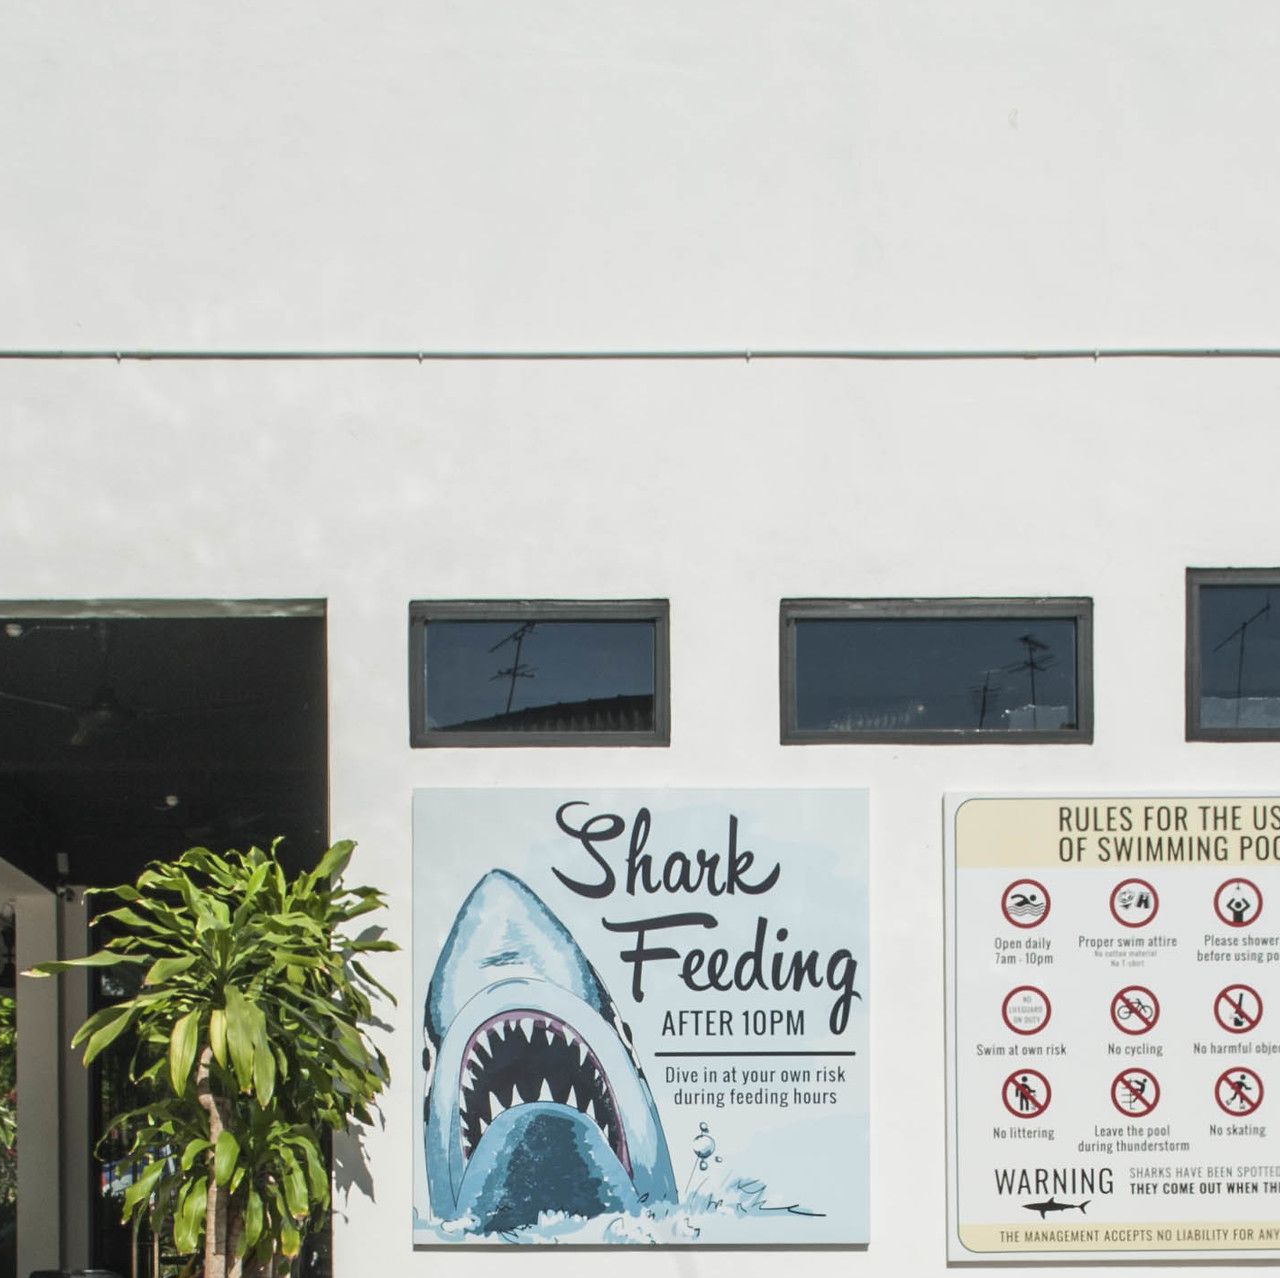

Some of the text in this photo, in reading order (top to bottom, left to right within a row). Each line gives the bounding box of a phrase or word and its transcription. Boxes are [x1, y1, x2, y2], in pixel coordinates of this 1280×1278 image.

[1059, 806, 1132, 832] RULES
[1145, 806, 1187, 831] FOR
[1198, 806, 1242, 830] THE
[552, 801, 780, 898] Shark
[1059, 837, 1087, 862] OF
[1098, 836, 1228, 862] SWIMMING
[995, 938, 1051, 951] Open daily
[1079, 936, 1177, 950] Proper swim attire
[1205, 934, 1279, 946] Please shower
[996, 952, 1016, 964] 7am
[1026, 952, 1053, 966] 10pm
[1197, 949, 1231, 962] before
[1234, 950, 1264, 963] using
[602, 912, 862, 1035] Feeding
[662, 1010, 804, 1036] AFTER 10PM
[977, 1044, 1066, 1056] Swim at own risk
[1108, 1043, 1163, 1057] No cycling
[1194, 1043, 1207, 1054] No
[1210, 1042, 1252, 1054] harmful
[666, 1066, 845, 1086] Dive in at your own risk
[674, 1089, 836, 1108] during feeding hours
[993, 1127, 1054, 1141] No littering
[1095, 1125, 1170, 1138] Leave the pool
[1210, 1124, 1266, 1137] No skating
[1078, 1140, 1189, 1154] during thunderstorm
[1130, 1167, 1171, 1178] SHARKS
[1176, 1167, 1202, 1178] HAVE
[1207, 1166, 1232, 1178] BEEN
[995, 1168, 1113, 1196] WARNING
[1130, 1183, 1157, 1194] THEY
[1163, 1183, 1194, 1194] COME
[1199, 1182, 1221, 1194] OUT
[1227, 1182, 1258, 1193] WHEN
[1000, 1231, 1019, 1243] THE
[1025, 1230, 1099, 1242] MANAGEMENT
[1104, 1230, 1152, 1242] ACCEPTS
[1157, 1229, 1172, 1241] NO
[1177, 1229, 1228, 1241] LIABILITY
[1233, 1229, 1253, 1240] FOR
[1258, 1229, 1280, 1240] ANY
